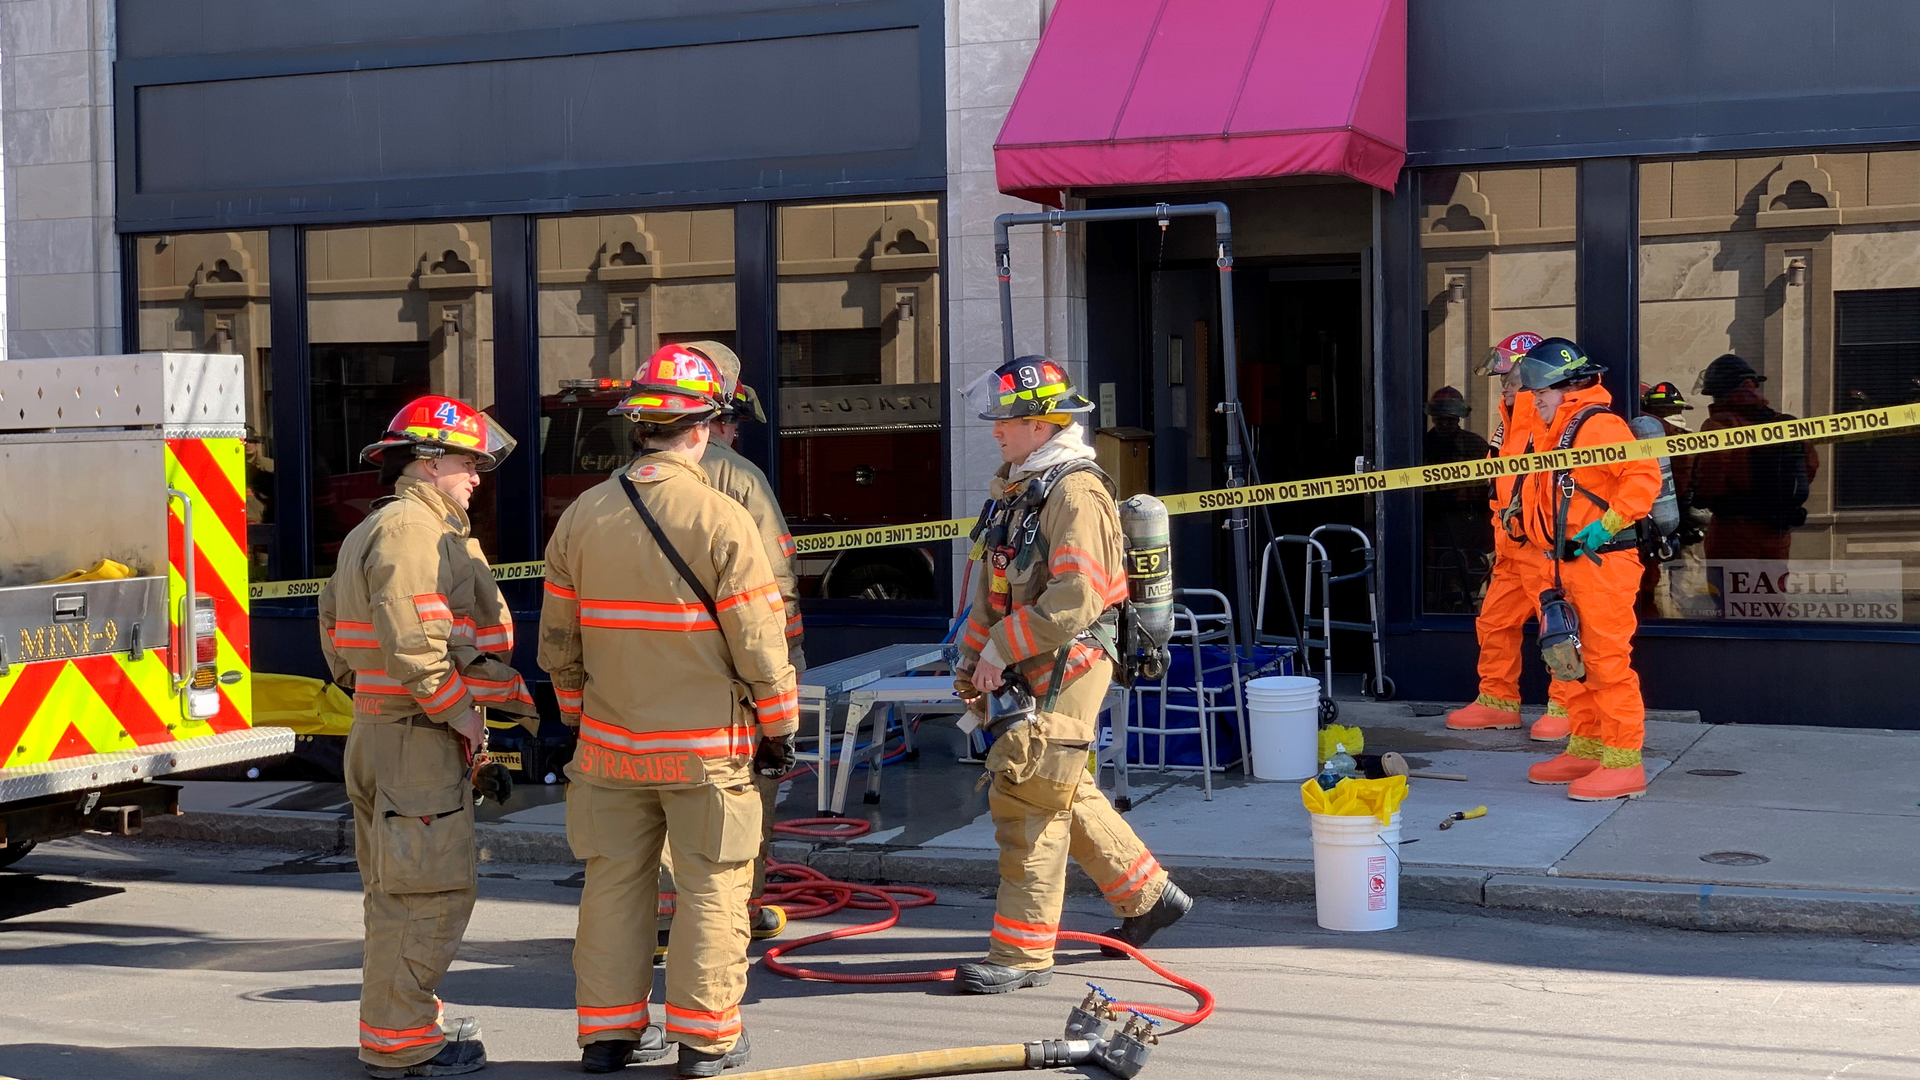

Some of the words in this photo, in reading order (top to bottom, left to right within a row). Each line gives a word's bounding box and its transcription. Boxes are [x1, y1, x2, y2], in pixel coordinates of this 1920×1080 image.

[1560, 349, 1572, 362] 9
[1018, 365, 1040, 389] 9
[434, 402, 460, 427] 4
[1828, 411, 1889, 433] POLICE
[1724, 428, 1757, 447] NOT
[1760, 425, 1784, 442] DO
[1787, 419, 1826, 439] LINE
[1666, 433, 1719, 454] CROSS
[1532, 452, 1568, 470] LINE
[1570, 445, 1627, 465] POLICE
[1422, 464, 1471, 483] CROSS
[1475, 460, 1505, 477] NOT
[1508, 457, 1530, 473] DO
[1278, 484, 1299, 500] DO
[1300, 480, 1333, 498] LINE
[1335, 474, 1387, 494] POLICE
[1198, 490, 1244, 509] CROSS
[1247, 487, 1276, 504] NOT
[837, 532, 863, 548] NOT
[865, 530, 882, 545] DO
[884, 527, 913, 543] LINE
[915, 522, 959, 540] POLICE
[796, 535, 835, 552] CROSS
[507, 565, 522, 578] DO
[1136, 554, 1161, 574] E9
[490, 567, 505, 580] NO
[287, 581, 320, 596] CROSS
[1728, 571, 1849, 596] EAGLE
[1729, 601, 1898, 620] NEWSPAPERS
[19, 619, 118, 661] MINI-9
[487, 754, 521, 764] ustrite
[580, 744, 692, 782] SYRACUSE
